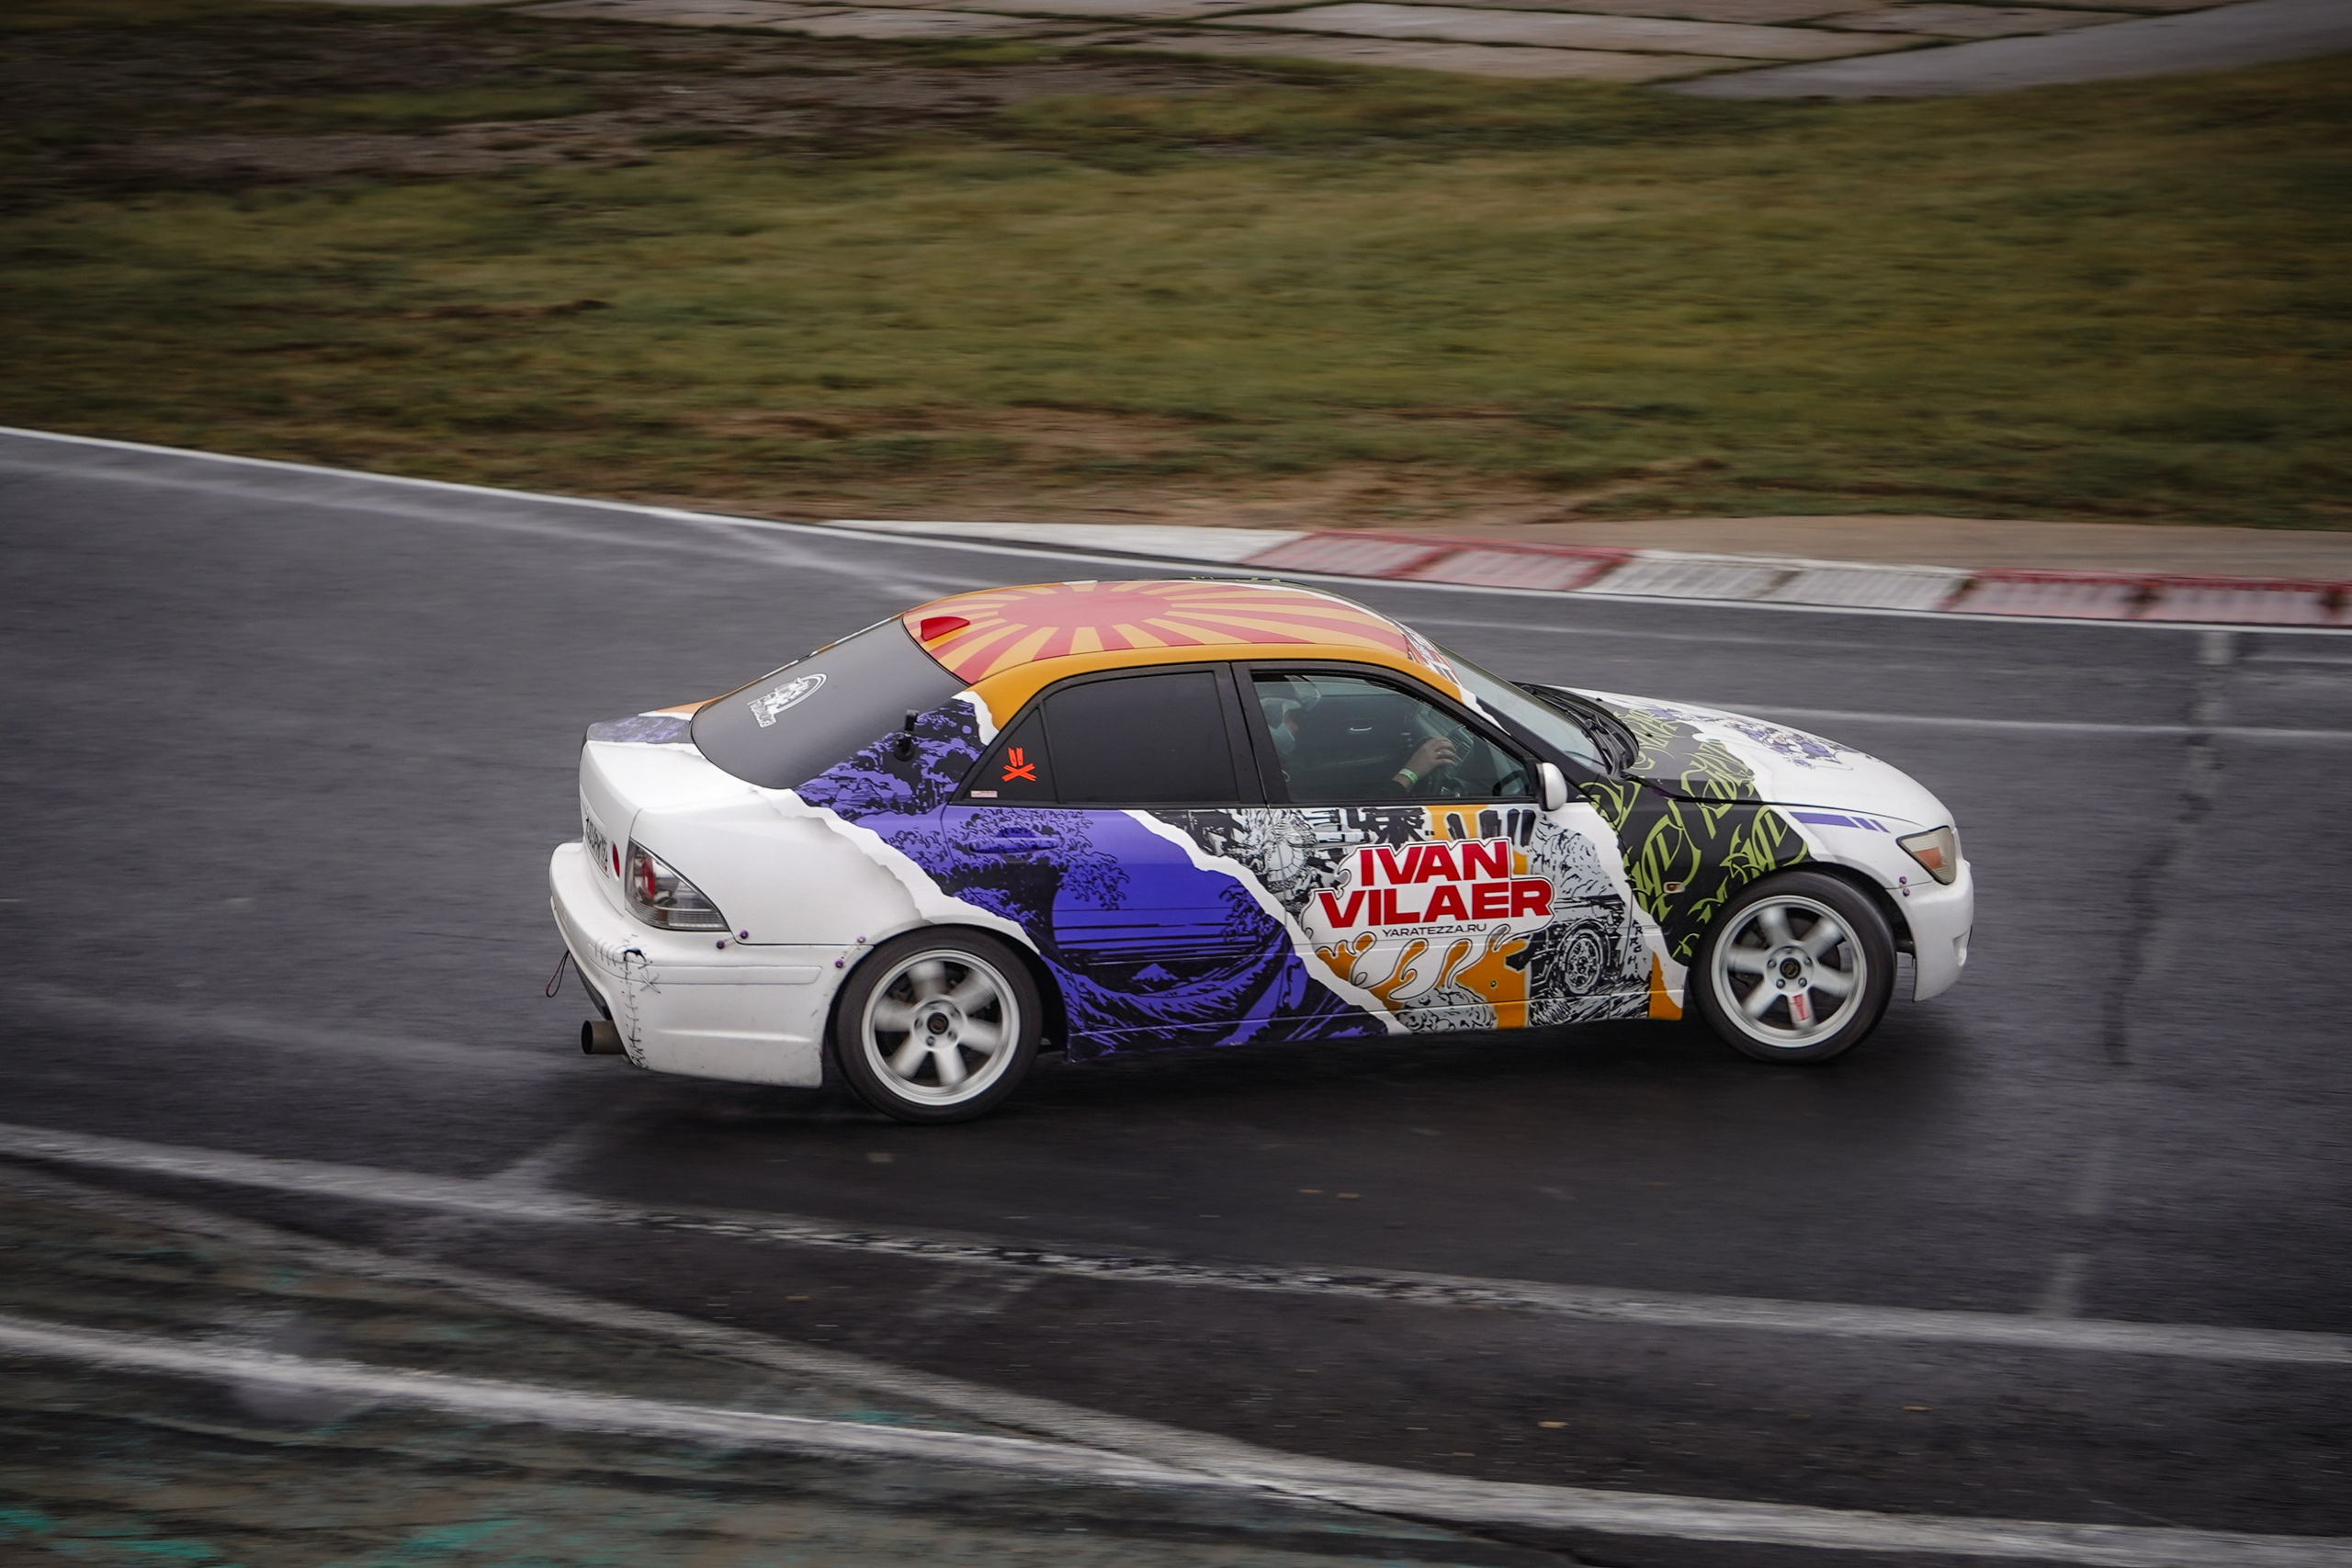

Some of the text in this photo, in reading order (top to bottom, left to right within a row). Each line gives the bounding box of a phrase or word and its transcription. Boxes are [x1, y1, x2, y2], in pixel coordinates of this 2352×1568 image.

[1360, 841, 1508, 886] IVAN
[1318, 879, 1554, 928] VILAER
[1382, 923, 1487, 938] YARATEZZA.RU
